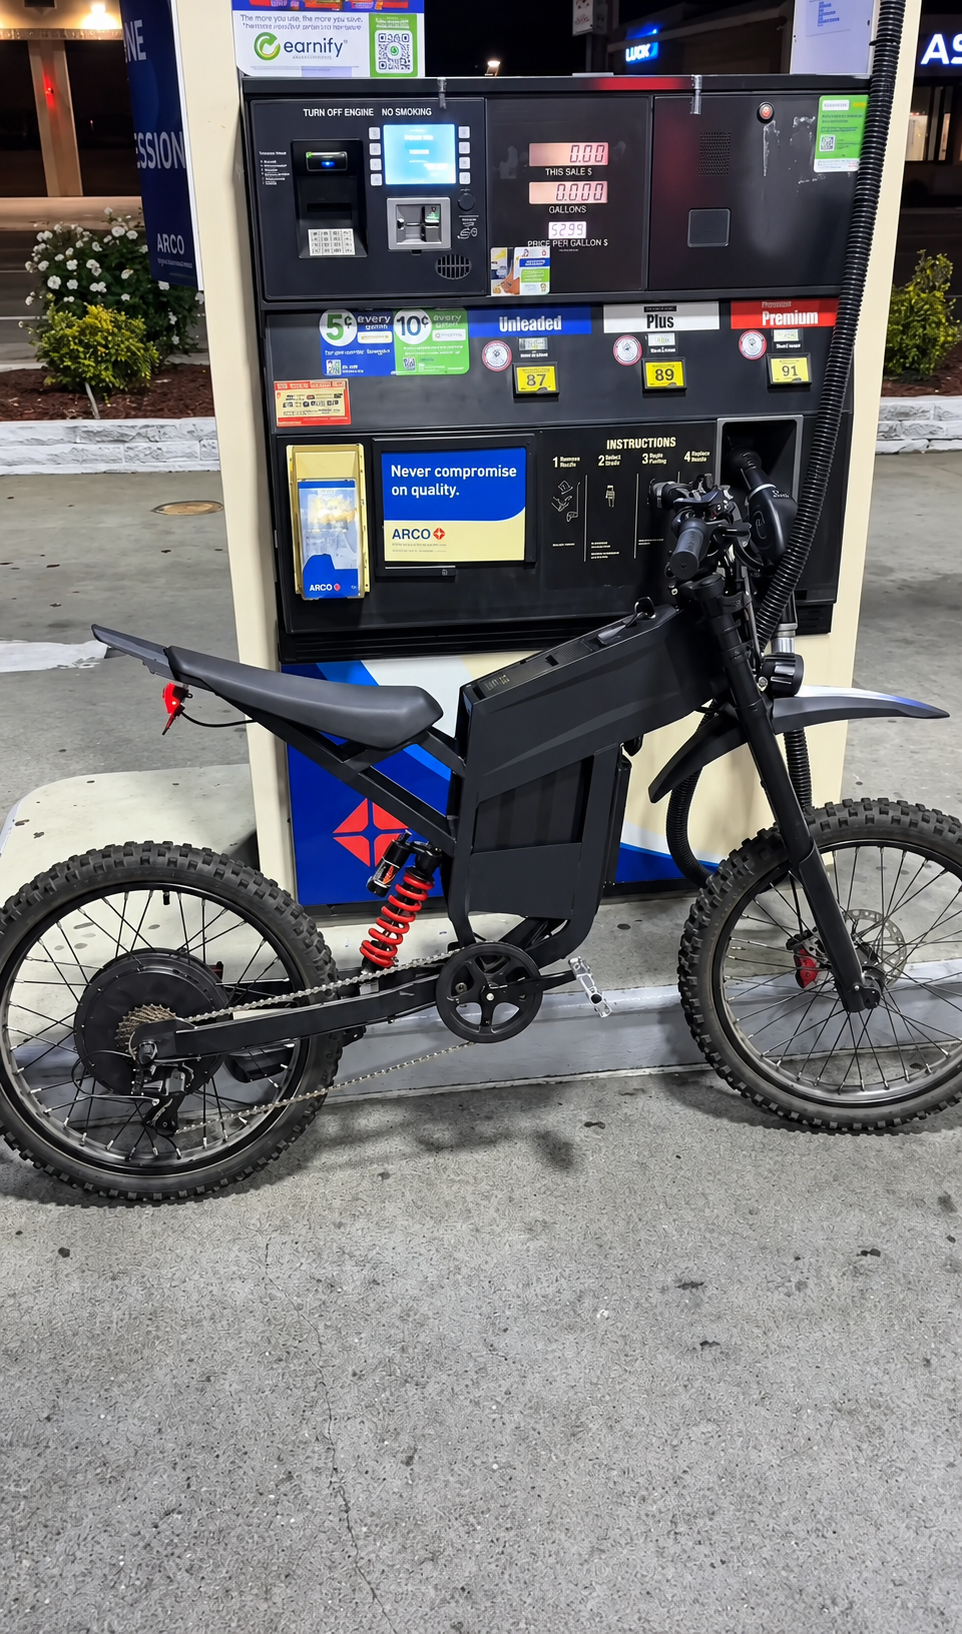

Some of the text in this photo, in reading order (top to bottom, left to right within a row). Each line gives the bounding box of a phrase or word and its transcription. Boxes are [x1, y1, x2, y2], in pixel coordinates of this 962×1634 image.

[283, 37, 343, 57] earnify
[303, 107, 433, 117] TURN OFF ENGINE NO SMOKING
[569, 144, 605, 163] 0.00
[545, 167, 593, 176] THIS SALE $
[556, 183, 604, 202] 0.000
[549, 205, 587, 214] GALLONS
[157, 233, 185, 255] ARCO
[527, 238, 609, 248] PRICE PER GALLON $
[499, 315, 562, 332] Unleaded
[646, 313, 674, 329] Plus
[762, 309, 819, 326] Premium
[654, 367, 675, 382] 89
[781, 364, 799, 378] 91
[526, 373, 547, 387] 87
[606, 437, 677, 450] INSTRUCTIONS
[552, 456, 559, 468] 1
[598, 455, 605, 467] 2
[642, 453, 649, 465] 3
[684, 451, 691, 463] 4
[391, 464, 517, 480] Never compromise
[391, 483, 460, 499] on quality.
[392, 528, 431, 540] ARCO
[309, 583, 333, 592] ARCO
